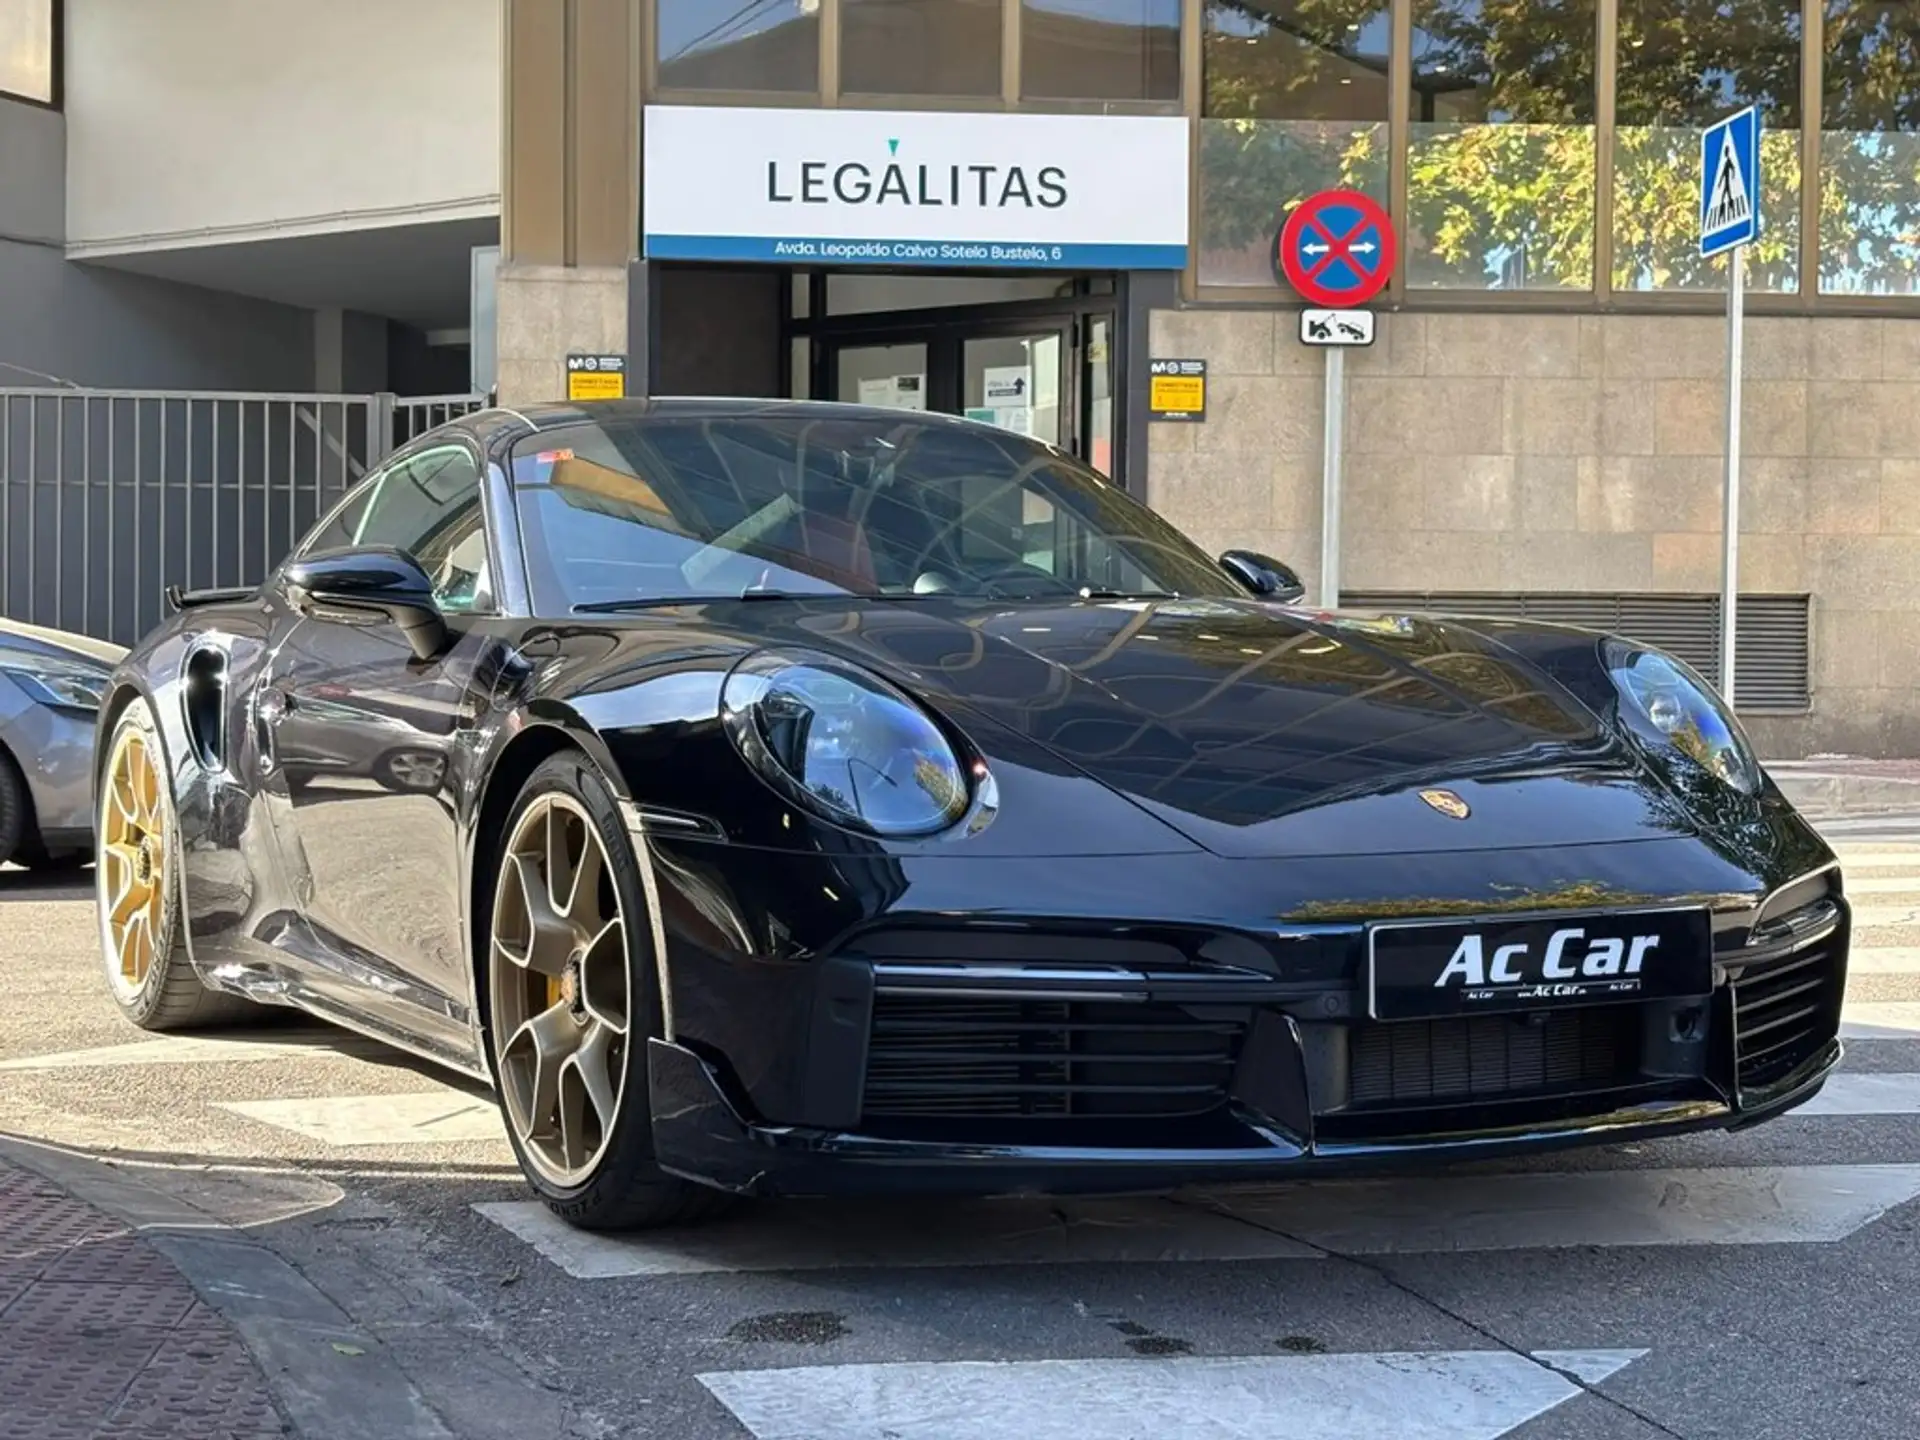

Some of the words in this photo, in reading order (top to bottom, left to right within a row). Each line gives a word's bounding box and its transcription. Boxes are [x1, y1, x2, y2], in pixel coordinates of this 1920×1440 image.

[774, 241, 817, 255] Avda.
[820, 241, 890, 260] Leopoldo
[893, 243, 938, 257] Calvo
[940, 244, 988, 259] Sotelo
[991, 245, 1049, 261] Bustelo,
[1051, 246, 1063, 260] 6
[1434, 935, 1529, 987] Ac
[1541, 928, 1660, 980] Car
